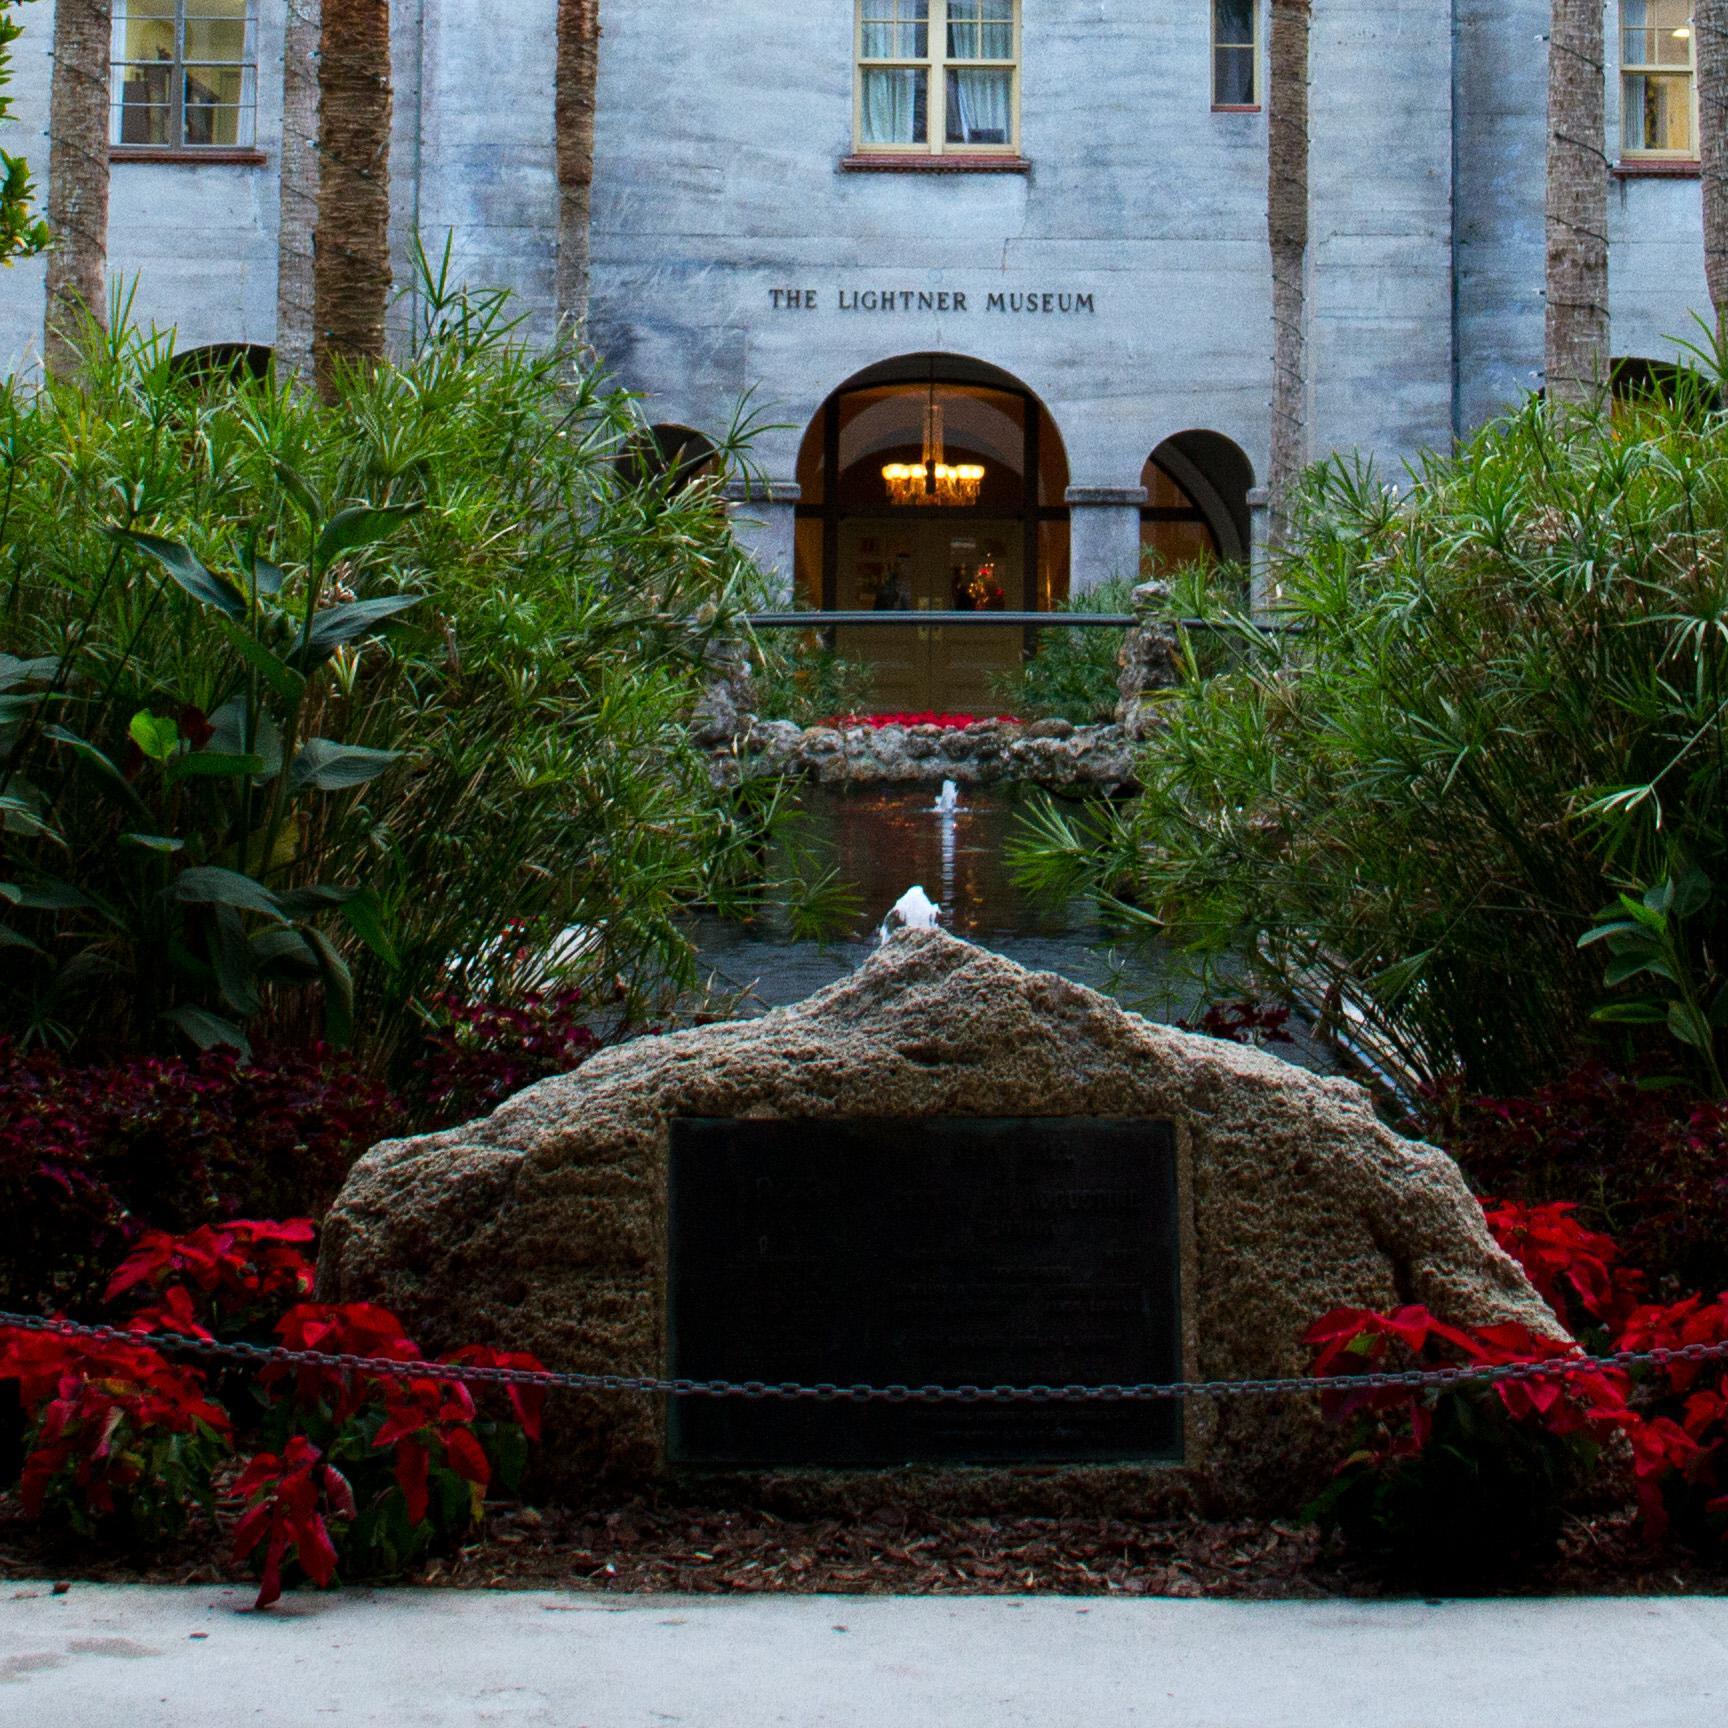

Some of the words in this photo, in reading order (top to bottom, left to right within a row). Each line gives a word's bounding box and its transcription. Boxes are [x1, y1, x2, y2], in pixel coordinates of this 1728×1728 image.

[768, 288, 817, 310] THE
[838, 289, 967, 311] LIGHTNER
[985, 292, 1095, 313] MUSEUM
